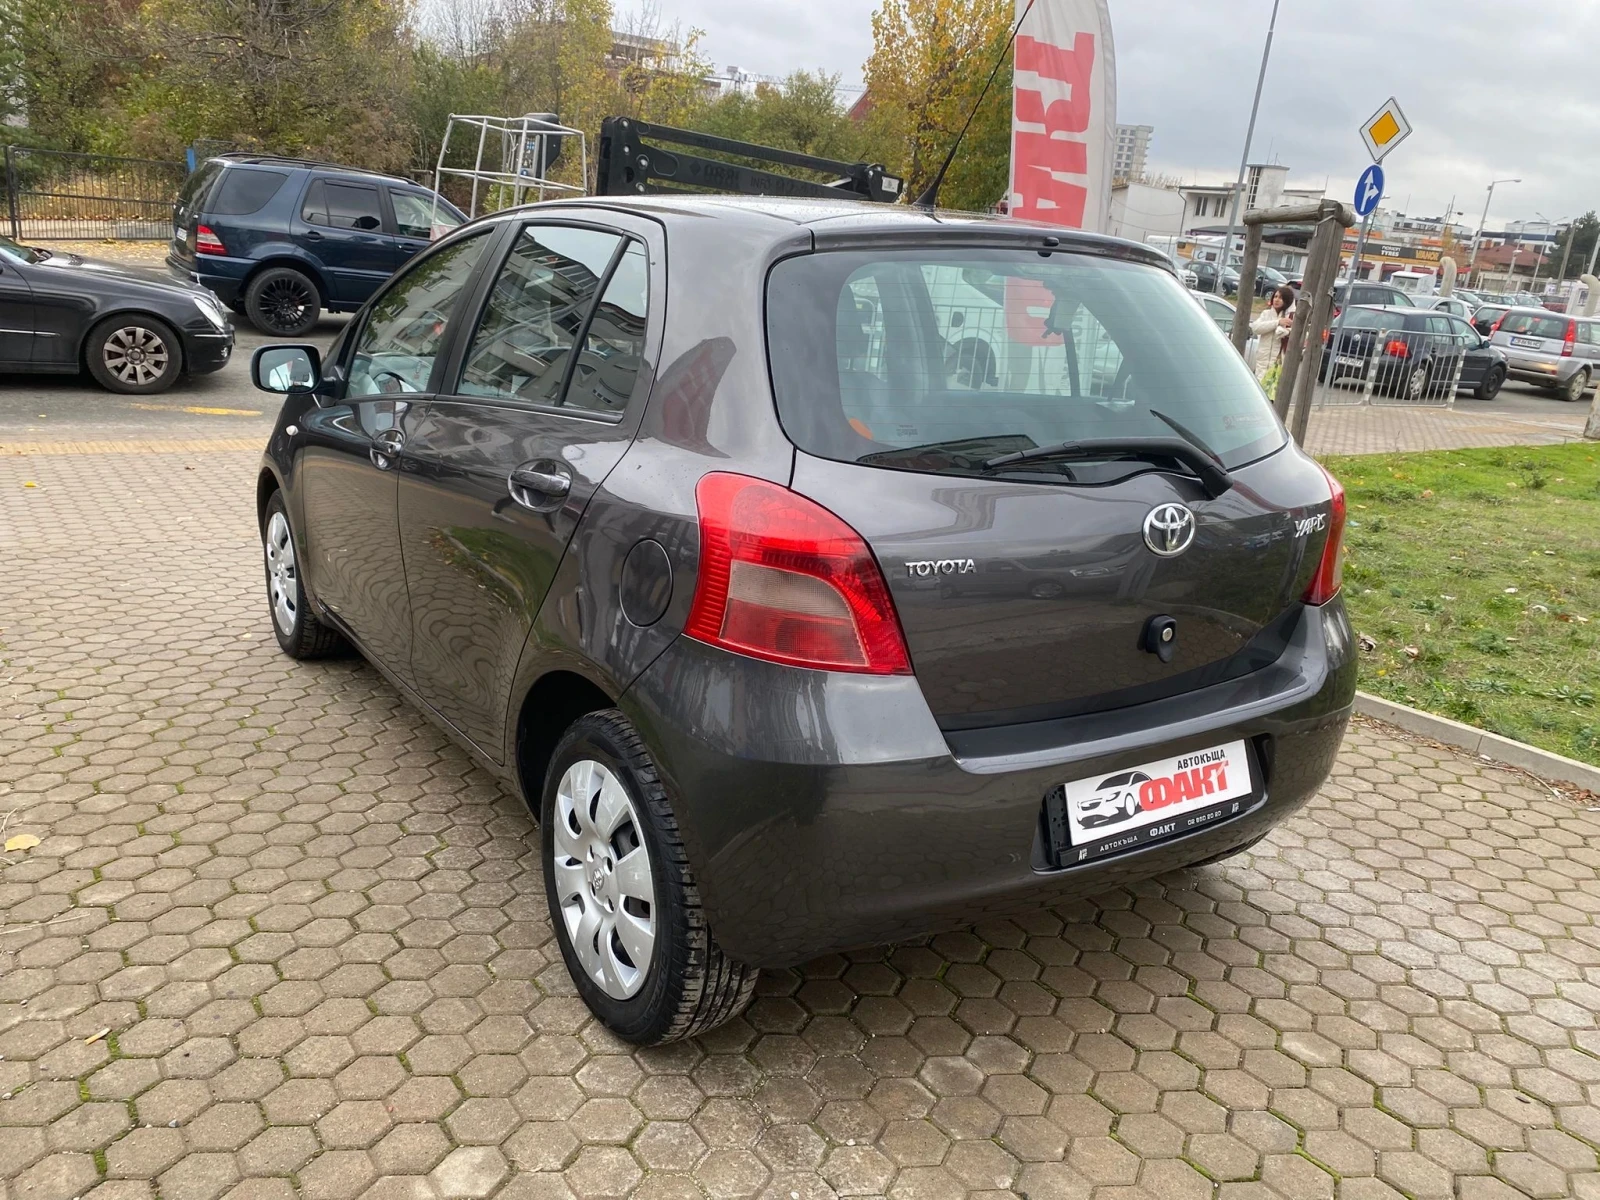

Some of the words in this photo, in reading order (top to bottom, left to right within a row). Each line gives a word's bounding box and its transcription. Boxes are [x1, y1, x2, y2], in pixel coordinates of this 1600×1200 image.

[1294, 512, 1327, 538] YARIS
[904, 559, 976, 577] TOYOTA
[1177, 749, 1226, 771] АВТОКЪЩА
[1139, 761, 1229, 812] ФАКТ
[1149, 822, 1176, 838] ФАКТ
